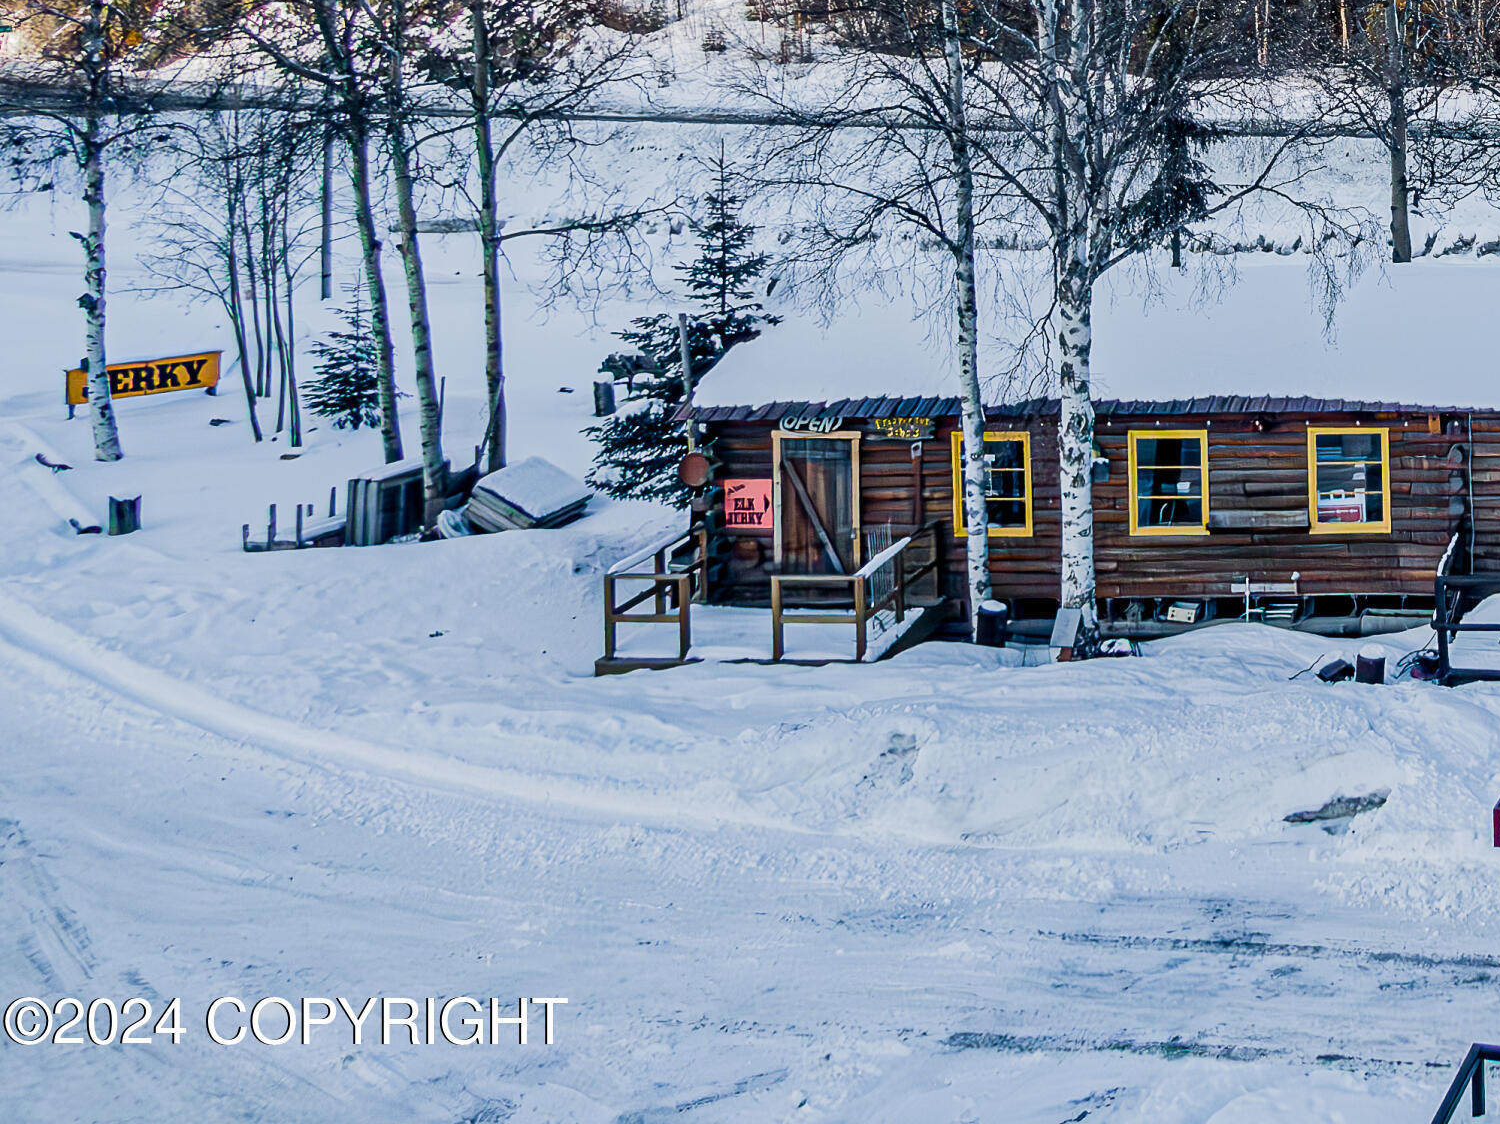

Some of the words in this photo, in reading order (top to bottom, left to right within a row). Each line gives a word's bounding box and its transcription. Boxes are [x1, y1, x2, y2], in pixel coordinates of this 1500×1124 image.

[82, 359, 208, 398] ERKY
[783, 416, 837, 433] OPEN
[734, 498, 754, 510] ELK
[727, 512, 763, 525] JERKY
